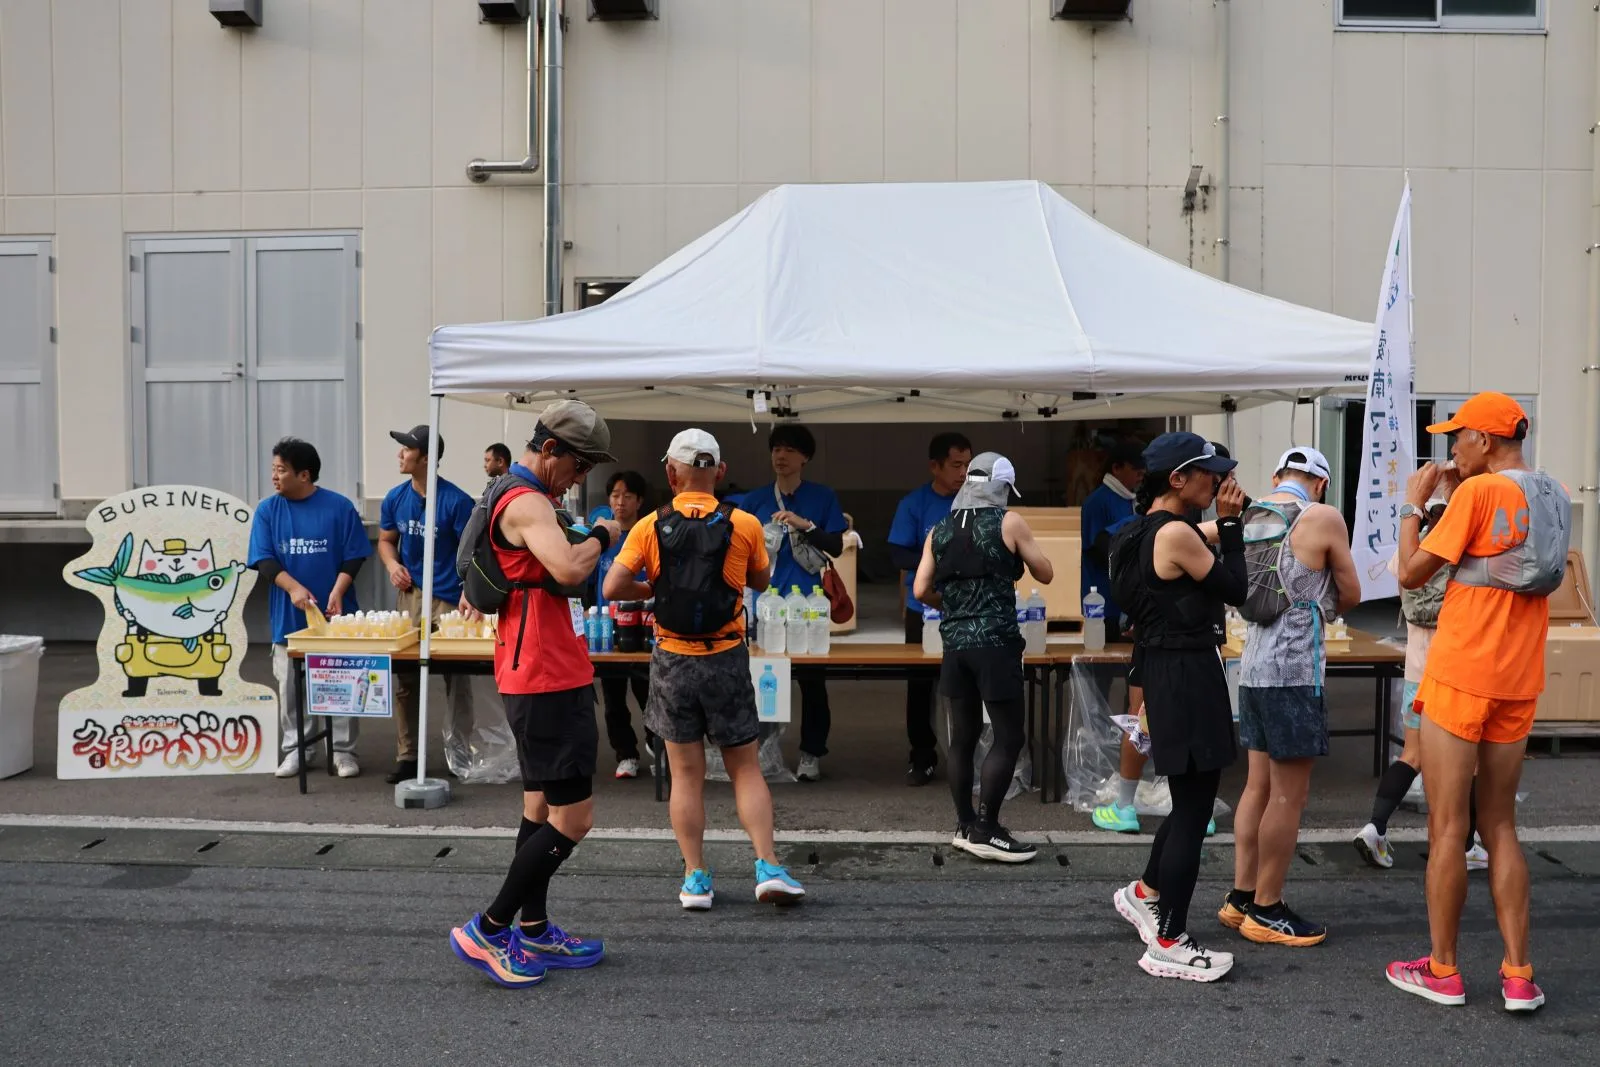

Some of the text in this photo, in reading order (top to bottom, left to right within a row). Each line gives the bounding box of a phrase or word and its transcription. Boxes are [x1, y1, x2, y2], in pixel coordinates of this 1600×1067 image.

[98, 490, 249, 524] BURINEKO
[289, 546, 314, 554] 2026
[319, 658, 377, 667] 体脂肪のスポドリ
[73, 711, 262, 772] 久良のぶり
[989, 836, 1010, 850] HOKA
